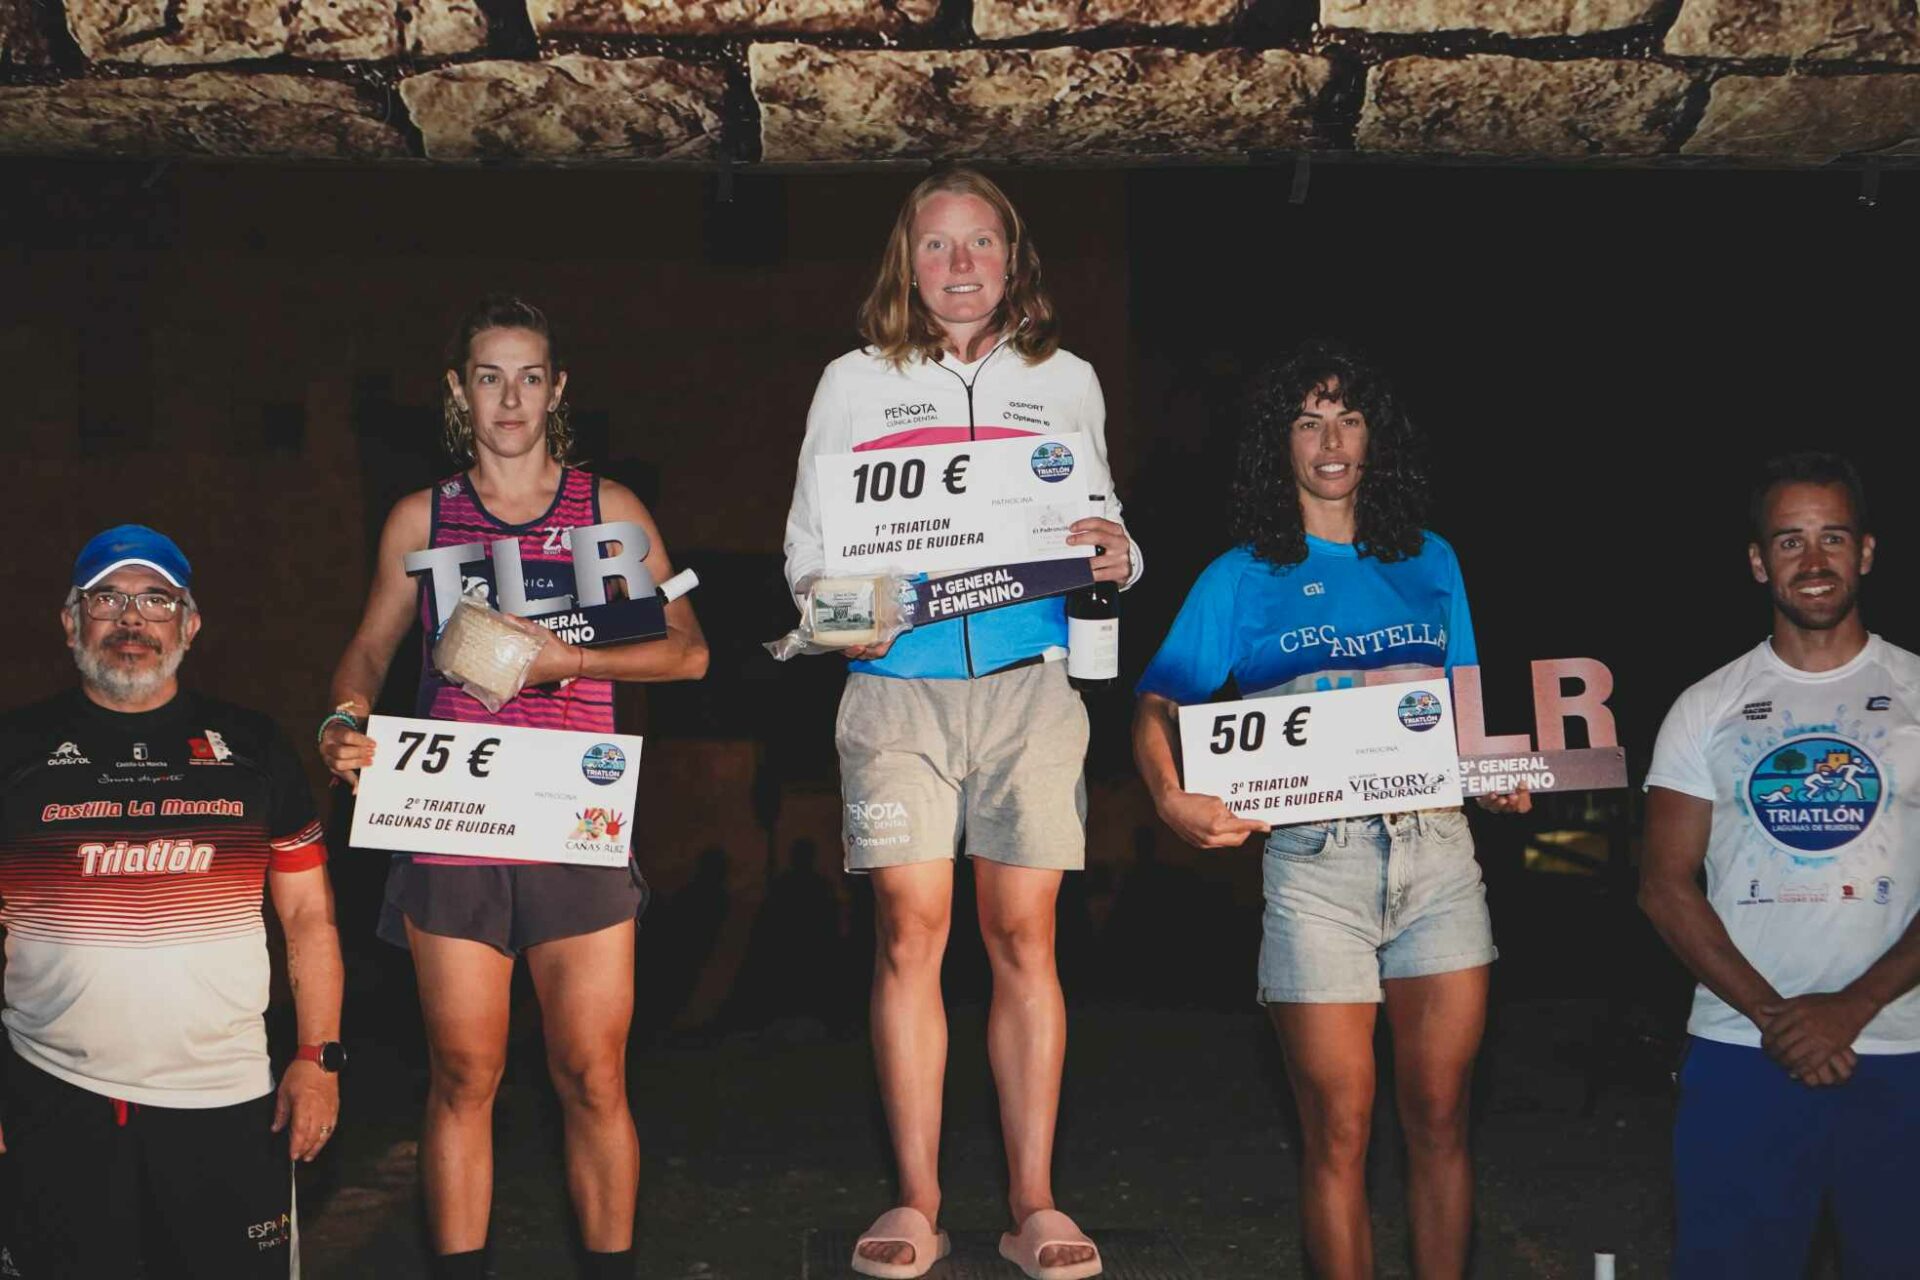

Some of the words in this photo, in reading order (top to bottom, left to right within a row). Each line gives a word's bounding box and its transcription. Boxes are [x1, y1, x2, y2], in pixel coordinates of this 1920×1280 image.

[884, 403, 937, 420] PEÑOTA
[913, 414, 938, 422] DENTAL
[852, 458, 926, 504] 100
[942, 453, 971, 495] €
[890, 518, 951, 535] TRIATLON
[842, 541, 903, 557] LAGUNAS
[906, 539, 923, 550] DE
[927, 532, 985, 548] RUIDERA
[945, 568, 1014, 597] GENERAL
[928, 581, 1025, 618] FEMENINO
[1209, 710, 1266, 755] 50
[1282, 705, 1312, 747] €
[394, 731, 455, 775] 75
[467, 738, 502, 778] €
[1478, 756, 1549, 773] GENERAL
[1248, 775, 1309, 793] TRIATLON
[1348, 772, 1429, 793] VICTORY
[1264, 796, 1280, 809] DE
[1284, 789, 1344, 807] RUIDERA
[1363, 785, 1437, 801] ENDURANCE
[42, 800, 123, 822] Castilla
[127, 799, 155, 817] La
[160, 798, 244, 817] Mancha
[422, 798, 486, 816] TRIATLON
[1766, 804, 1865, 824] TRIATLÓN
[368, 813, 431, 830] LAGUNAS
[435, 819, 451, 832] DE
[456, 820, 517, 836] RUIDERA
[1772, 823, 1811, 833] LAGUNAS
[1812, 823, 1823, 831] DE
[1824, 823, 1861, 832] RUIDERA
[565, 840, 601, 852] CAÑAS
[77, 838, 217, 877] Triatlón
